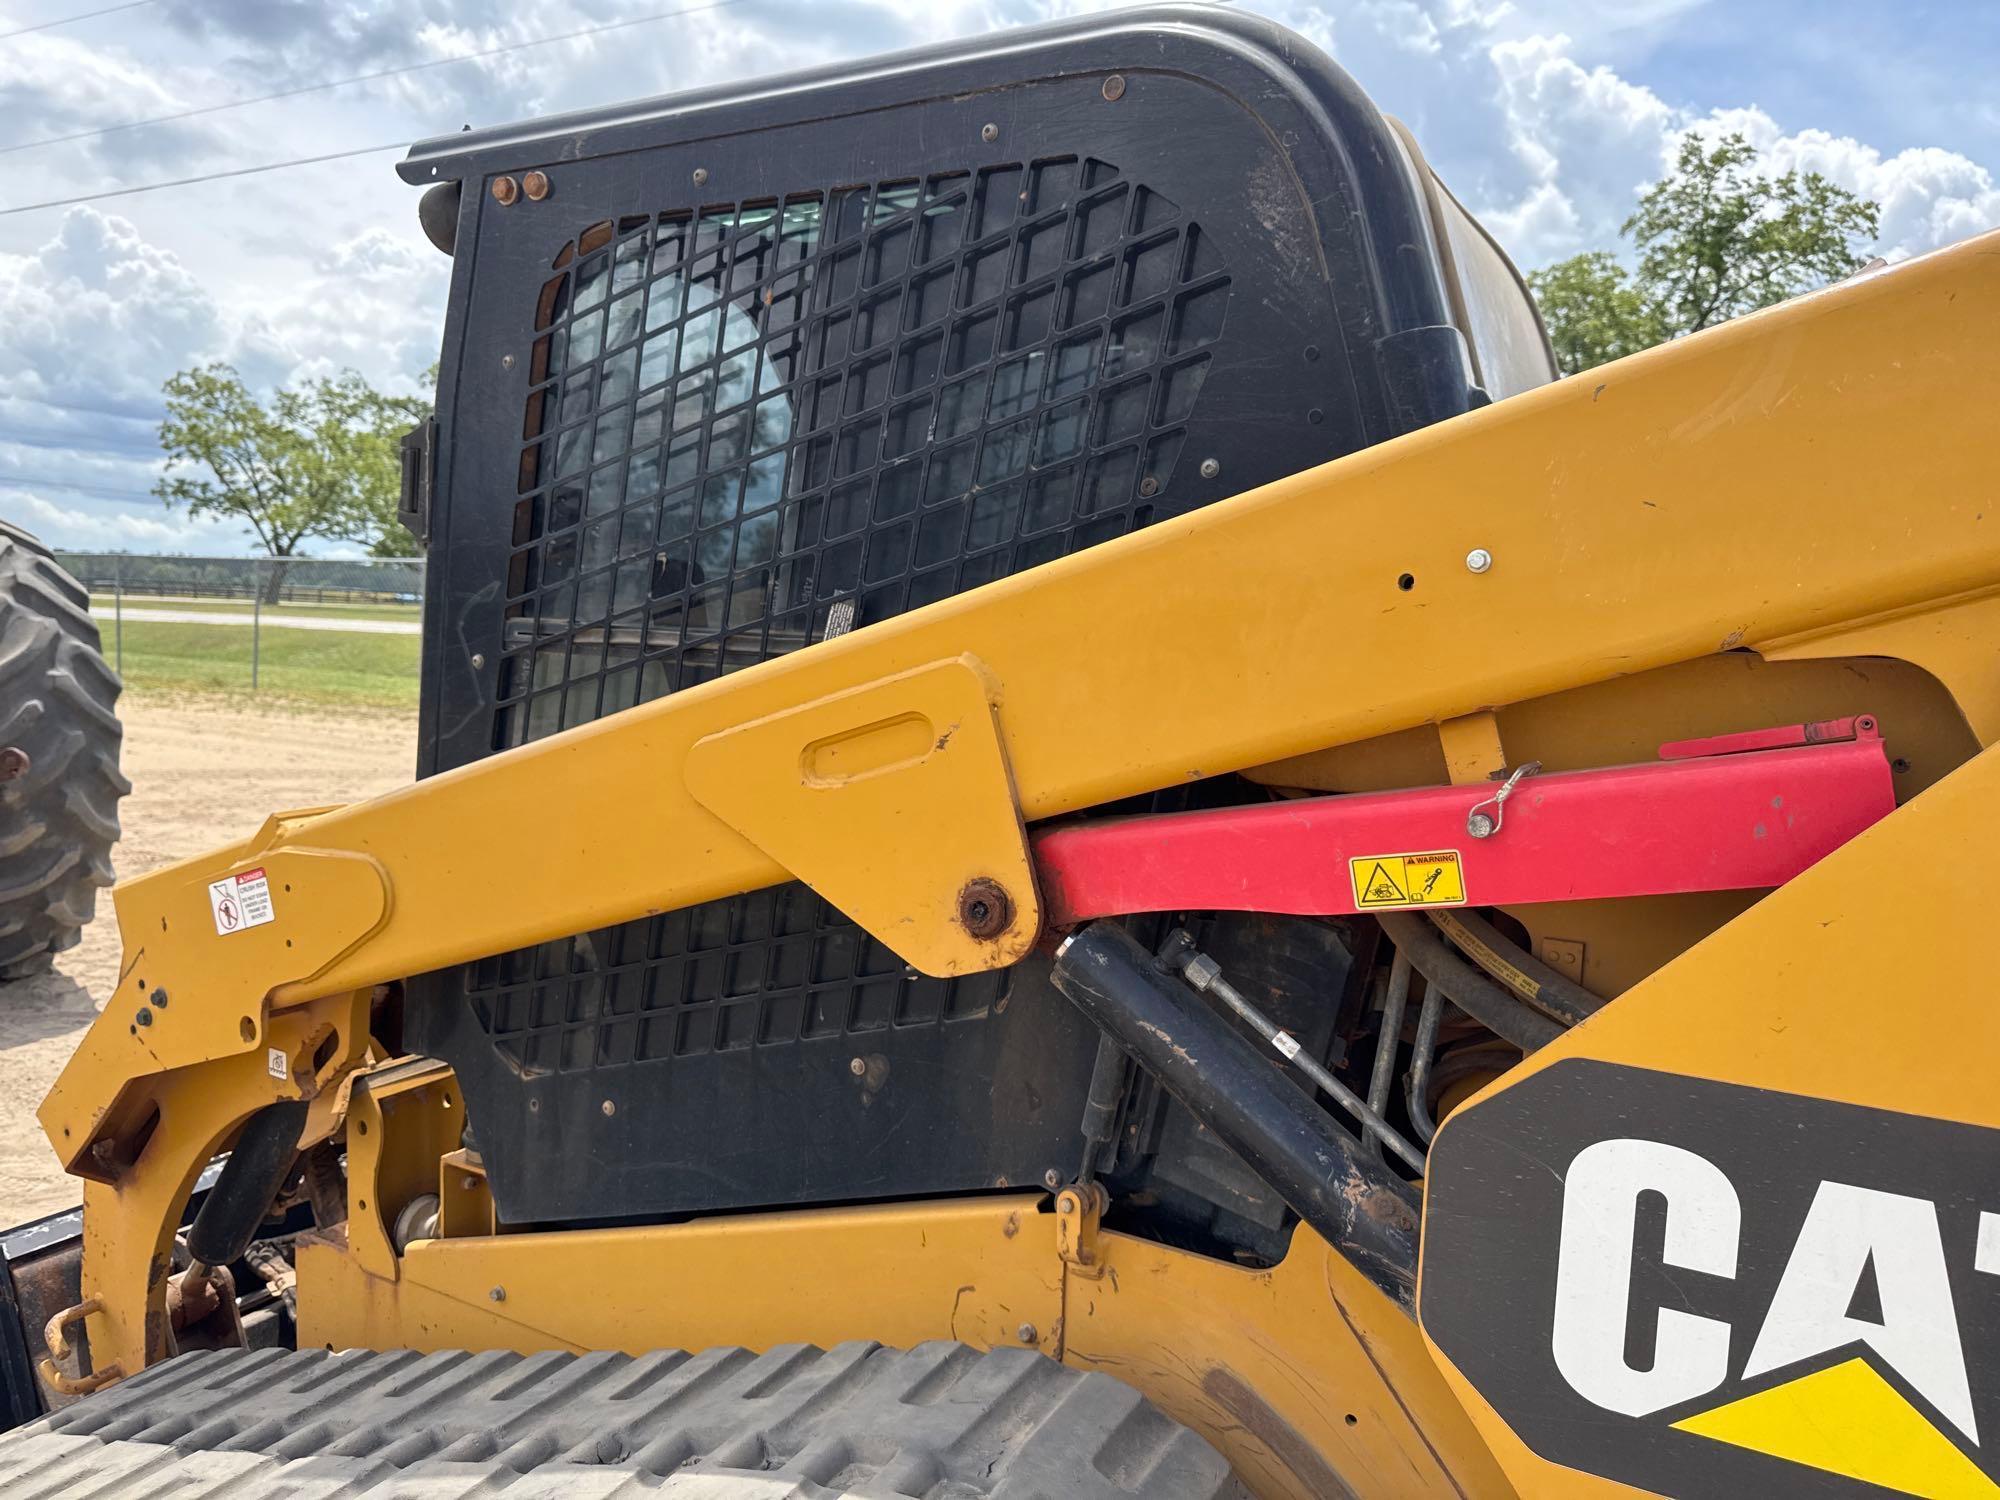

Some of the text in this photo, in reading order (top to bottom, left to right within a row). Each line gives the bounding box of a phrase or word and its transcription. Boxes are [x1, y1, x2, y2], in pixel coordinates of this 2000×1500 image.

[1416, 854, 1455, 864] WARNING
[244, 870, 263, 881] DANGER
[240, 881, 266, 894] CRUSH RISK
[1552, 1138, 2000, 1448] CA
